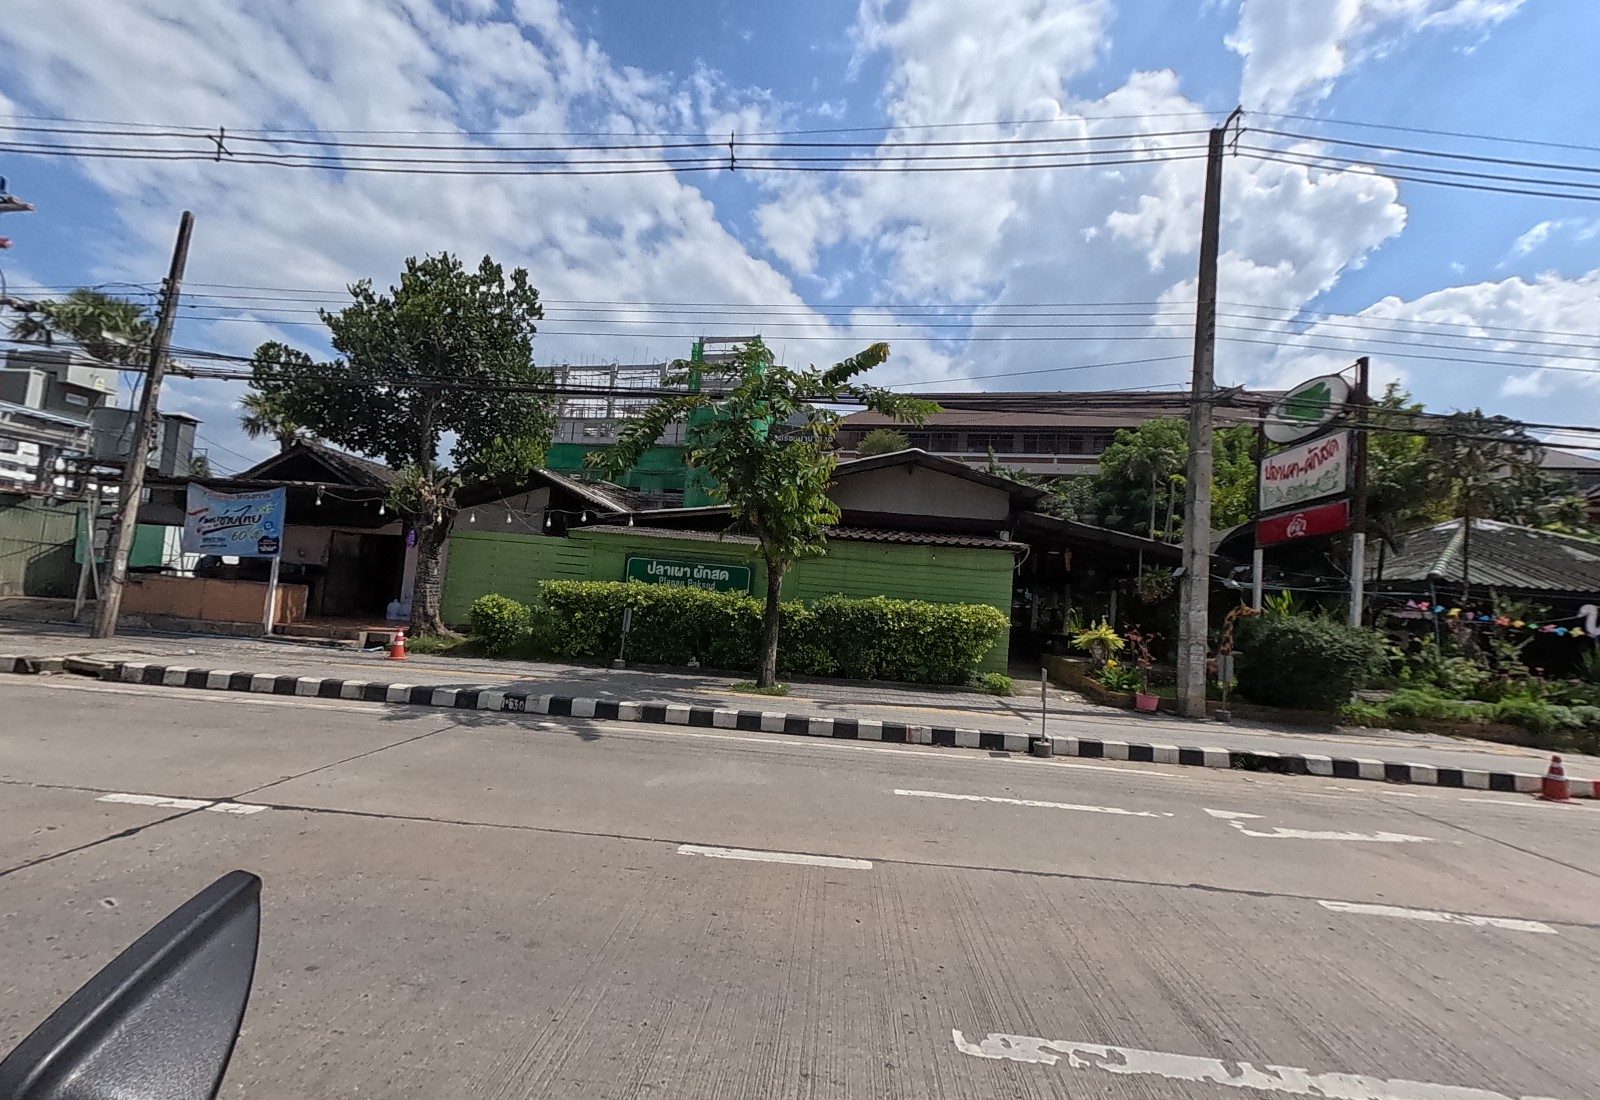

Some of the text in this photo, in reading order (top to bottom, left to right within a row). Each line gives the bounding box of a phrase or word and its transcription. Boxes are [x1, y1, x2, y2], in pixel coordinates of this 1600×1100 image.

[647, 561, 729, 581] ปลาเผา ผักสด
